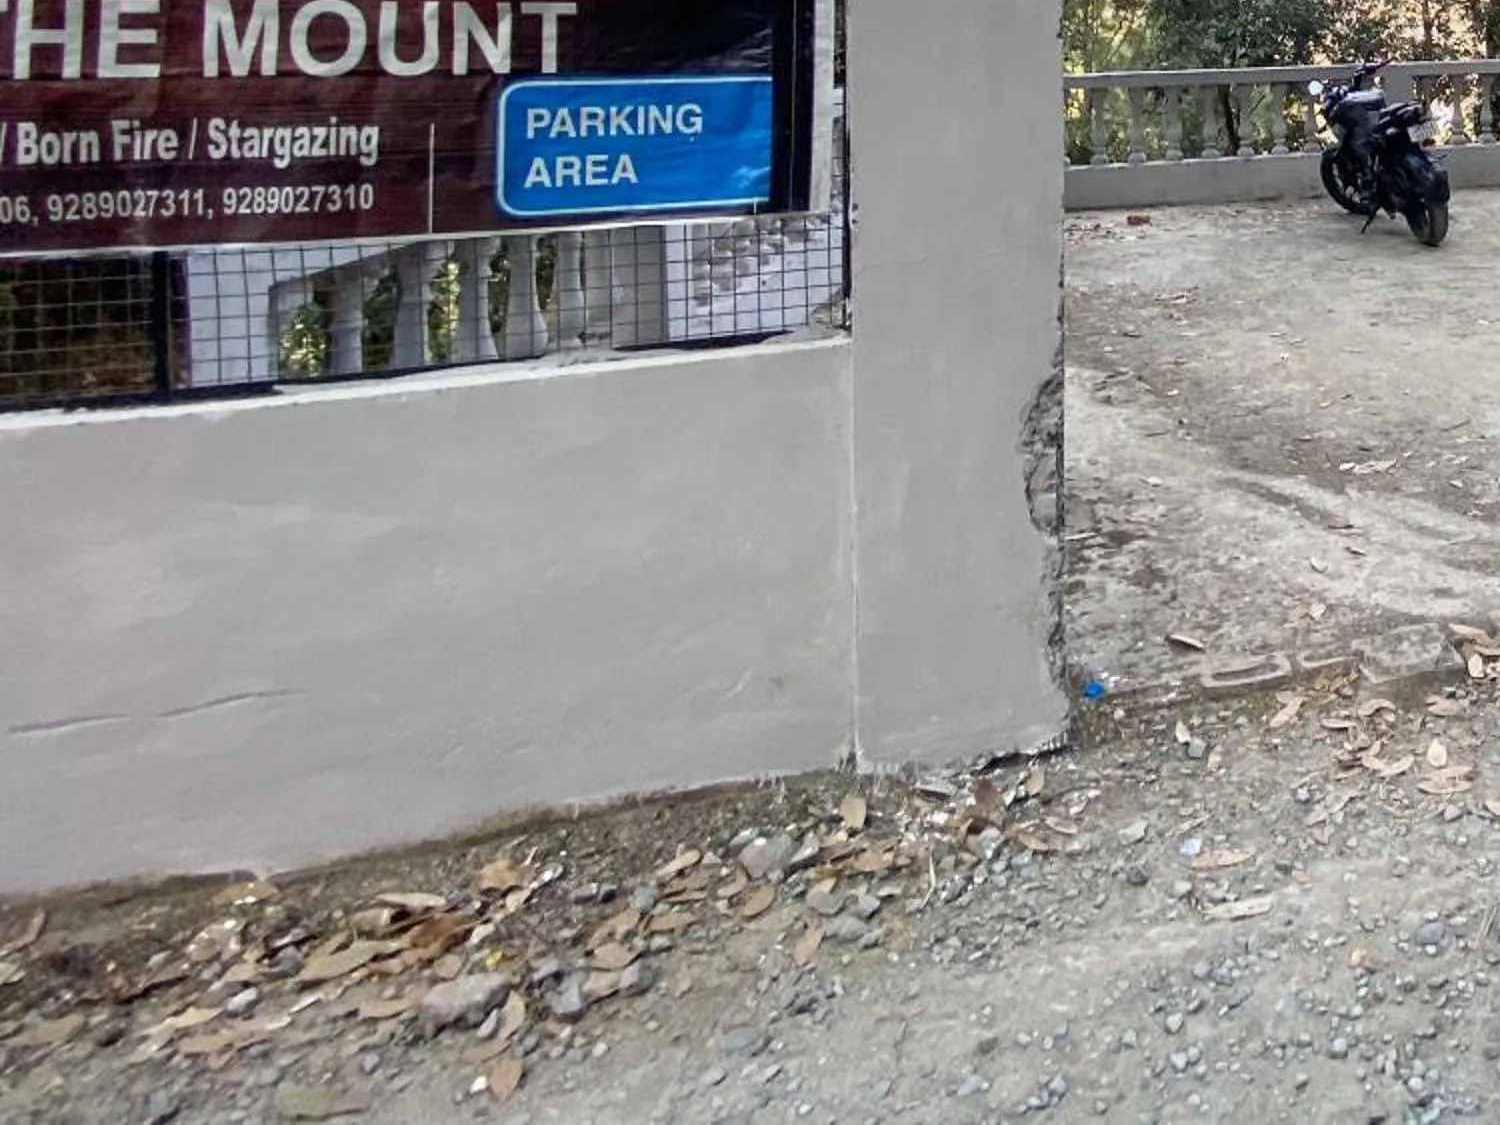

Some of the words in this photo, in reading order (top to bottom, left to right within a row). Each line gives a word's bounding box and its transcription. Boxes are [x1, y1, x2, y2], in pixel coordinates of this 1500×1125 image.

[525, 104, 705, 141] PARKING
[16, 121, 101, 165] Born
[112, 118, 180, 162] Fire
[189, 117, 199, 160] /
[207, 116, 381, 170] Stargazing
[523, 153, 639, 189] AREA
[47, 188, 215, 222] 9289027311,
[222, 182, 375, 216] 9289027310
